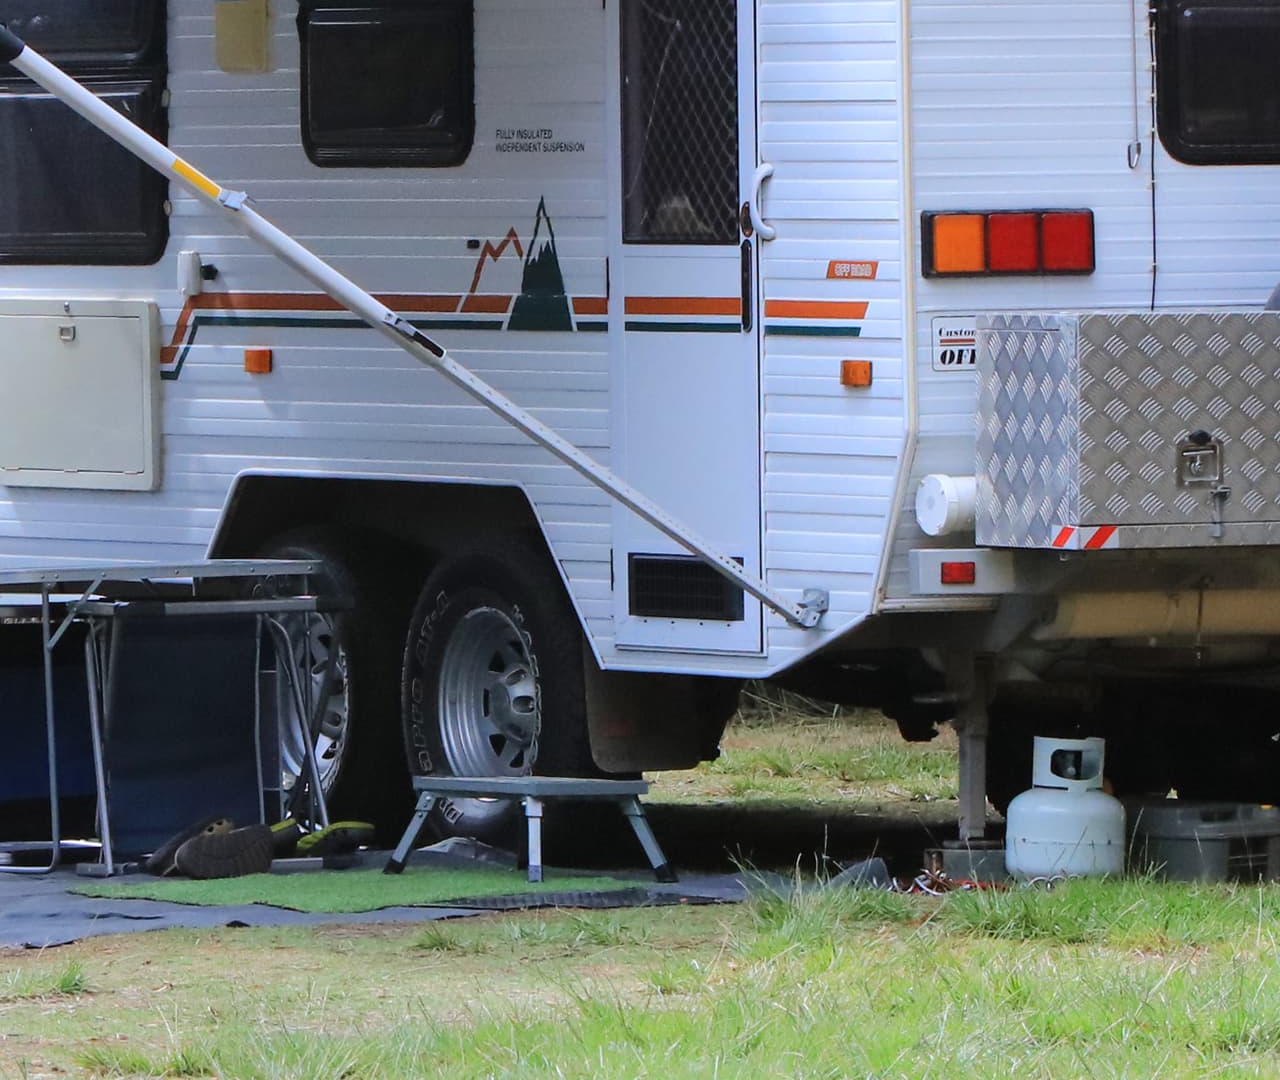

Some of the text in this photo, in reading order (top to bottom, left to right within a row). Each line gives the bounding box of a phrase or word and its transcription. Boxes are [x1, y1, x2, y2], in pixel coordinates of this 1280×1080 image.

[495, 128, 553, 140] FULLY INSULATED
[495, 142, 585, 153] INDEPENDENT SUSPENSION
[834, 263, 850, 277] OFF
